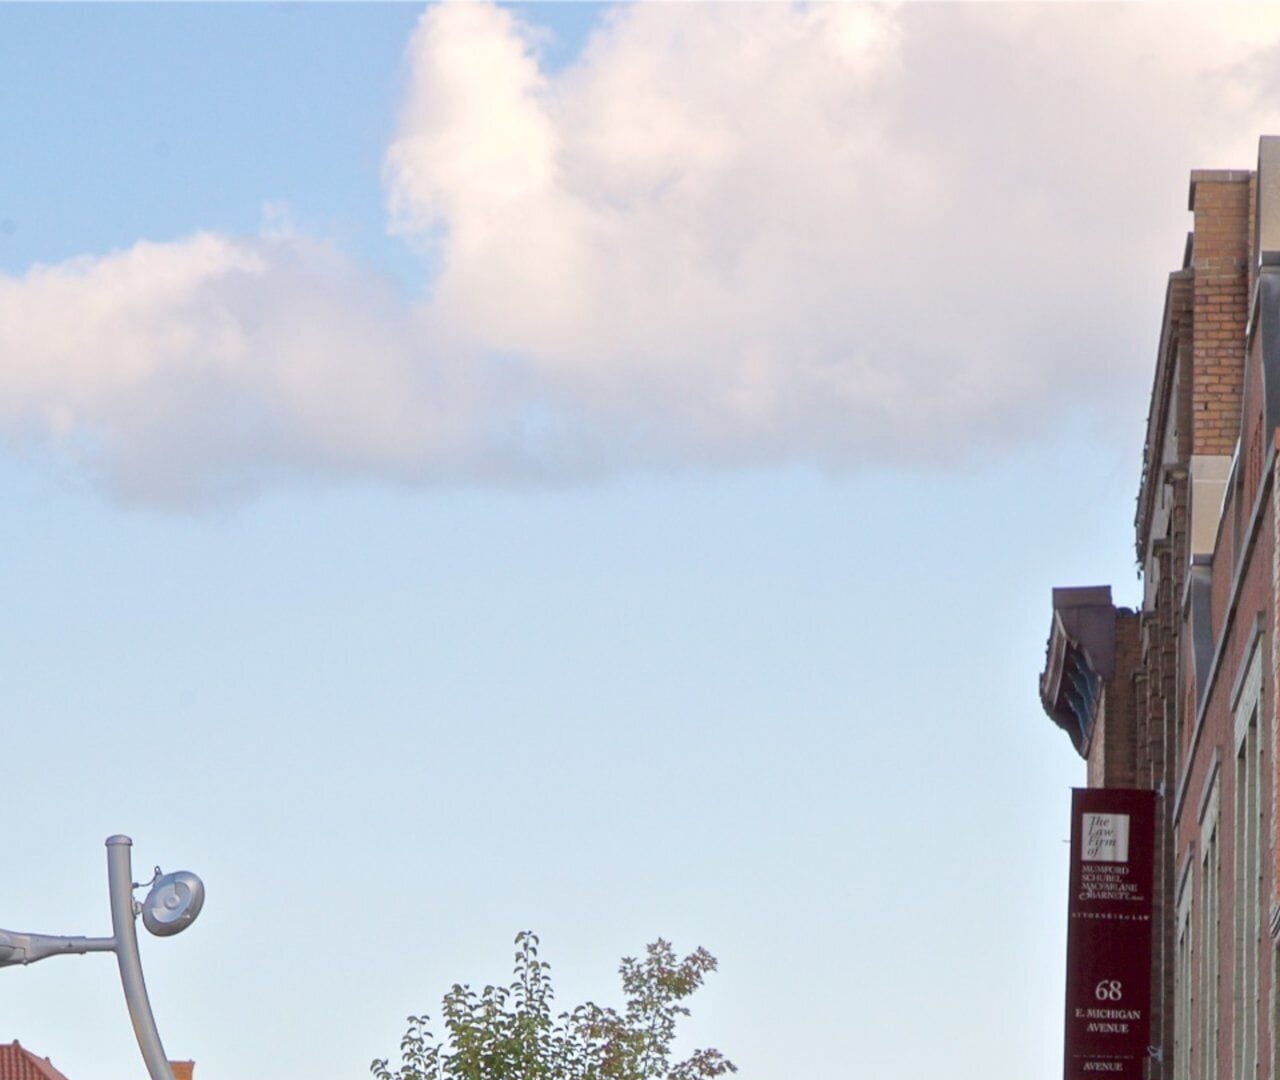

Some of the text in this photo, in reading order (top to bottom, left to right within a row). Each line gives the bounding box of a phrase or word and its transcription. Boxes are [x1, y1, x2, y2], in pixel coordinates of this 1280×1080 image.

[1089, 816, 1110, 826] The
[1088, 827, 1113, 836] Law
[1088, 836, 1117, 847] Firm
[1095, 980, 1123, 1001] 68
[1075, 1008, 1142, 1020] E. MICHIGAN
[1087, 1022, 1129, 1034] AVENUE
[1083, 1061, 1124, 1072] AVENUE
